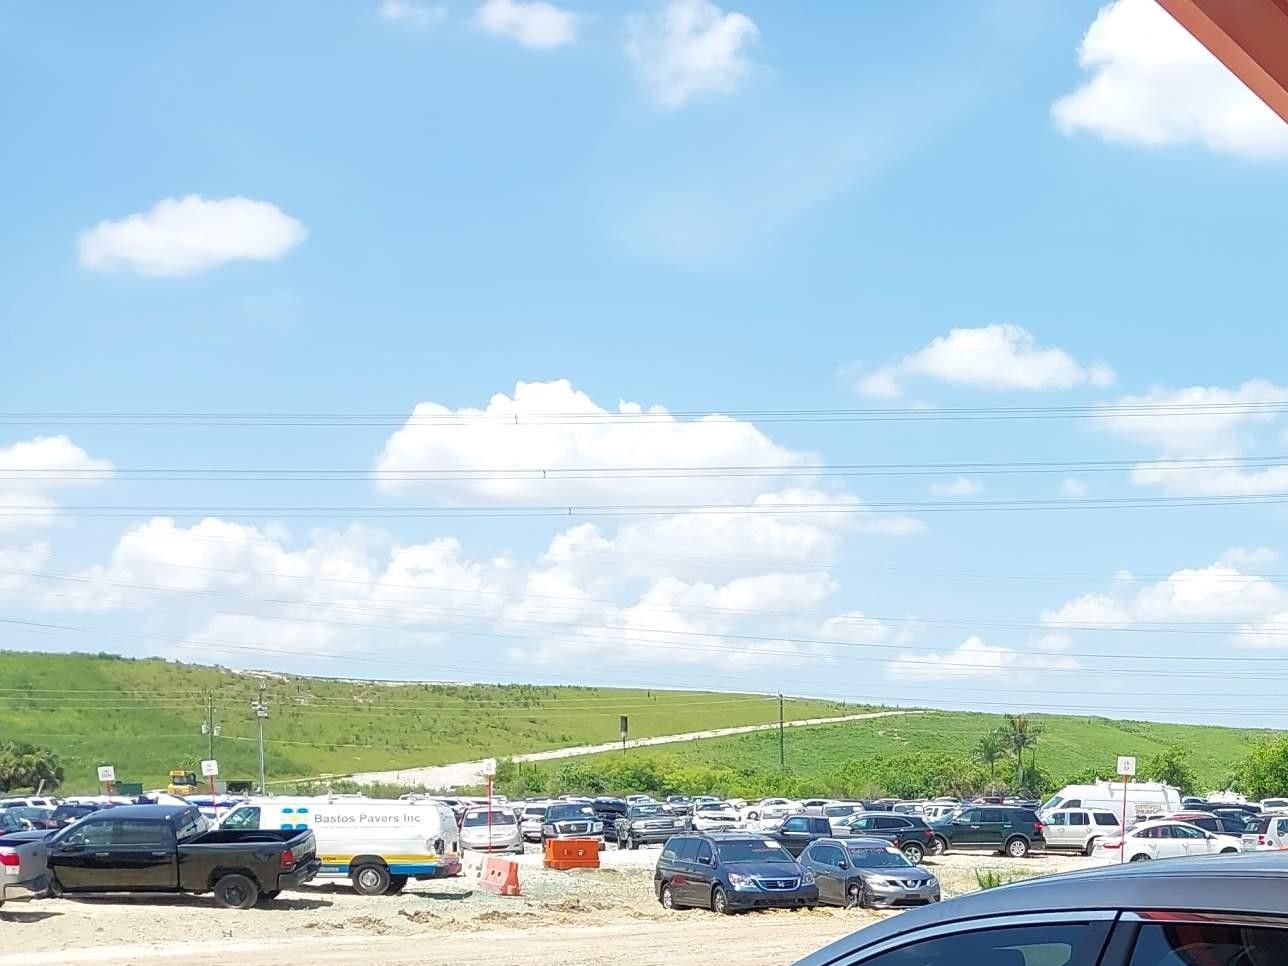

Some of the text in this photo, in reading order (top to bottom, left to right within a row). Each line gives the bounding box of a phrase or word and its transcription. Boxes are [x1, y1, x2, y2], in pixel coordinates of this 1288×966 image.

[314, 814, 421, 823] Bastos Pavers Inc
